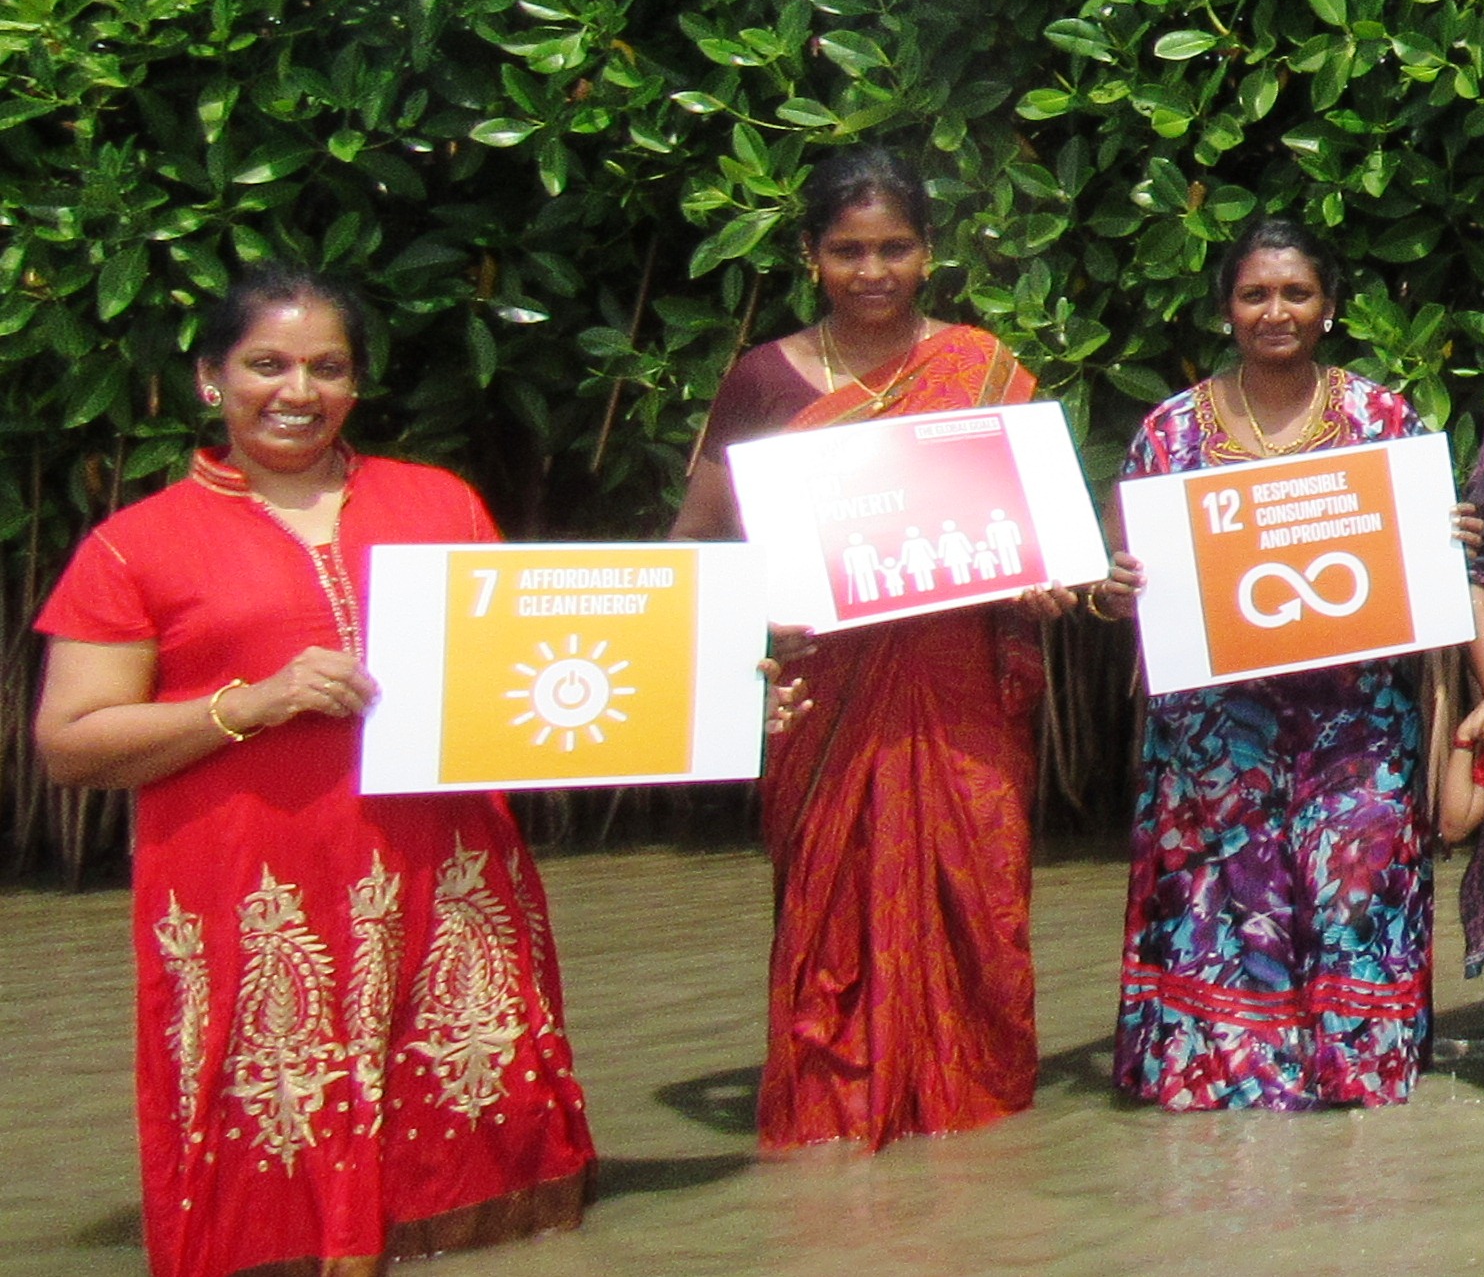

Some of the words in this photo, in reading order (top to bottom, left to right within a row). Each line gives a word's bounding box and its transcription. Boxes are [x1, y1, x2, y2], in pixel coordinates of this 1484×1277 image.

[1252, 471, 1348, 504] RESPONSIBLE
[814, 489, 906, 524] POVERTY
[1202, 489, 1243, 534] 12
[1255, 493, 1359, 526] CONSUMPTION
[1260, 528, 1290, 550] AND
[1291, 513, 1382, 546] PRODUCTION
[472, 569, 498, 617] 7
[520, 569, 635, 589] AFFORDABLE
[637, 567, 675, 589] AND
[519, 595, 578, 617] CLEAN
[579, 593, 649, 615] ENERGY
